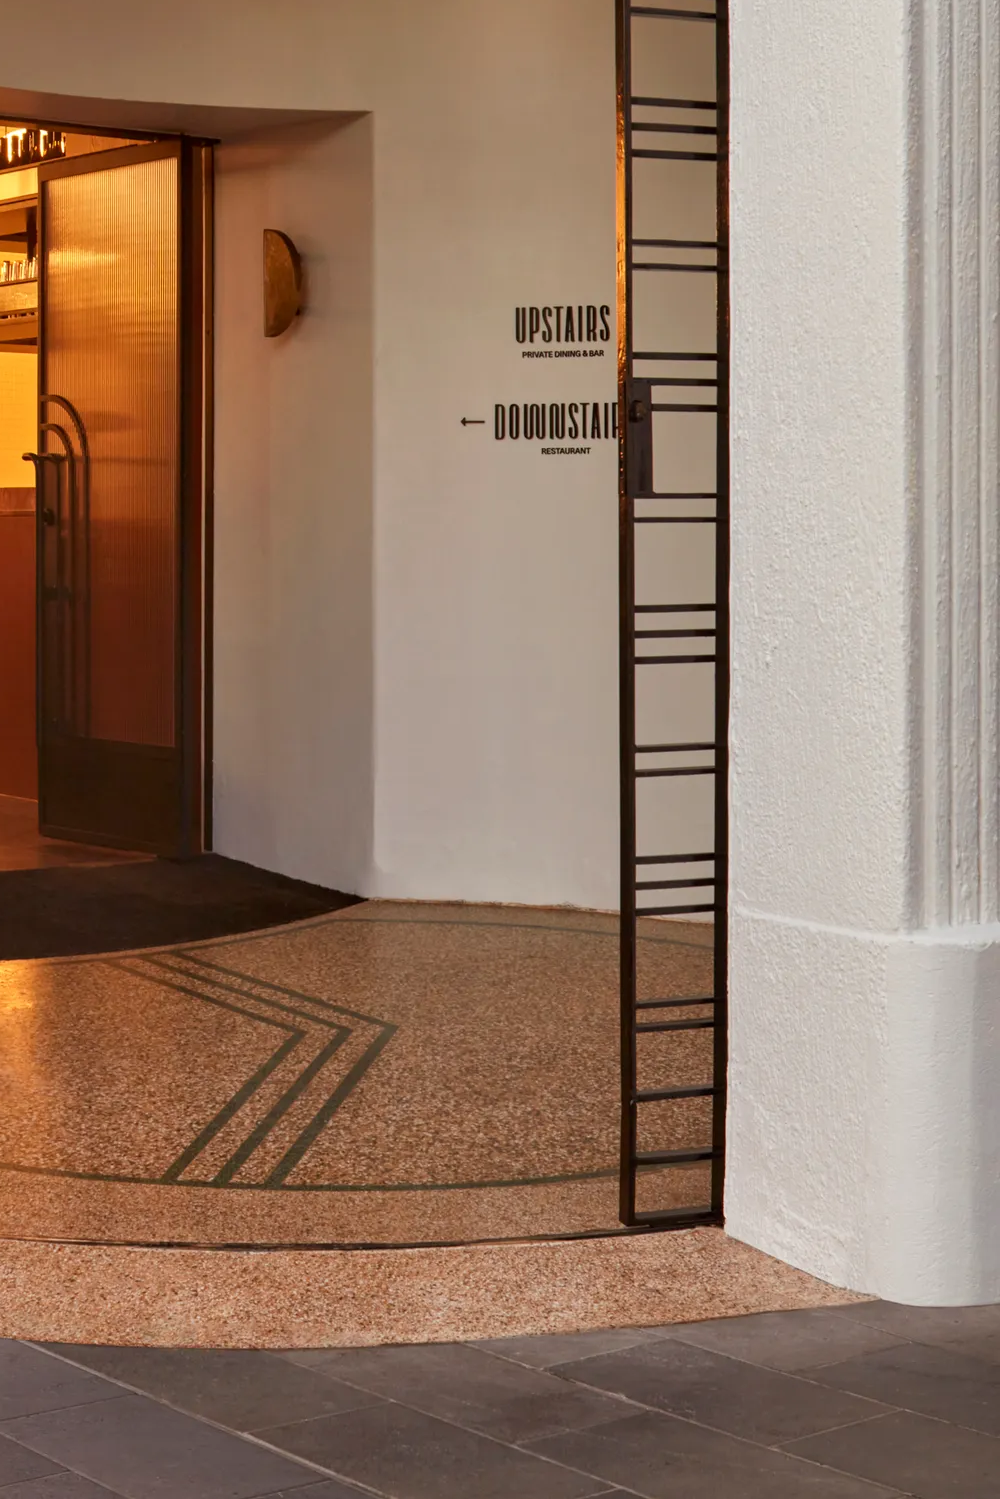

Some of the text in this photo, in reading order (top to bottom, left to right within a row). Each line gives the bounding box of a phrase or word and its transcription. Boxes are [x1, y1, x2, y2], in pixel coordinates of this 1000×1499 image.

[514, 304, 611, 344] UPSTAIRS
[521, 351, 553, 359] PRIVATE
[554, 350, 581, 358] DINING
[589, 349, 605, 357] BAR
[541, 447, 592, 455] RESTAURANT
